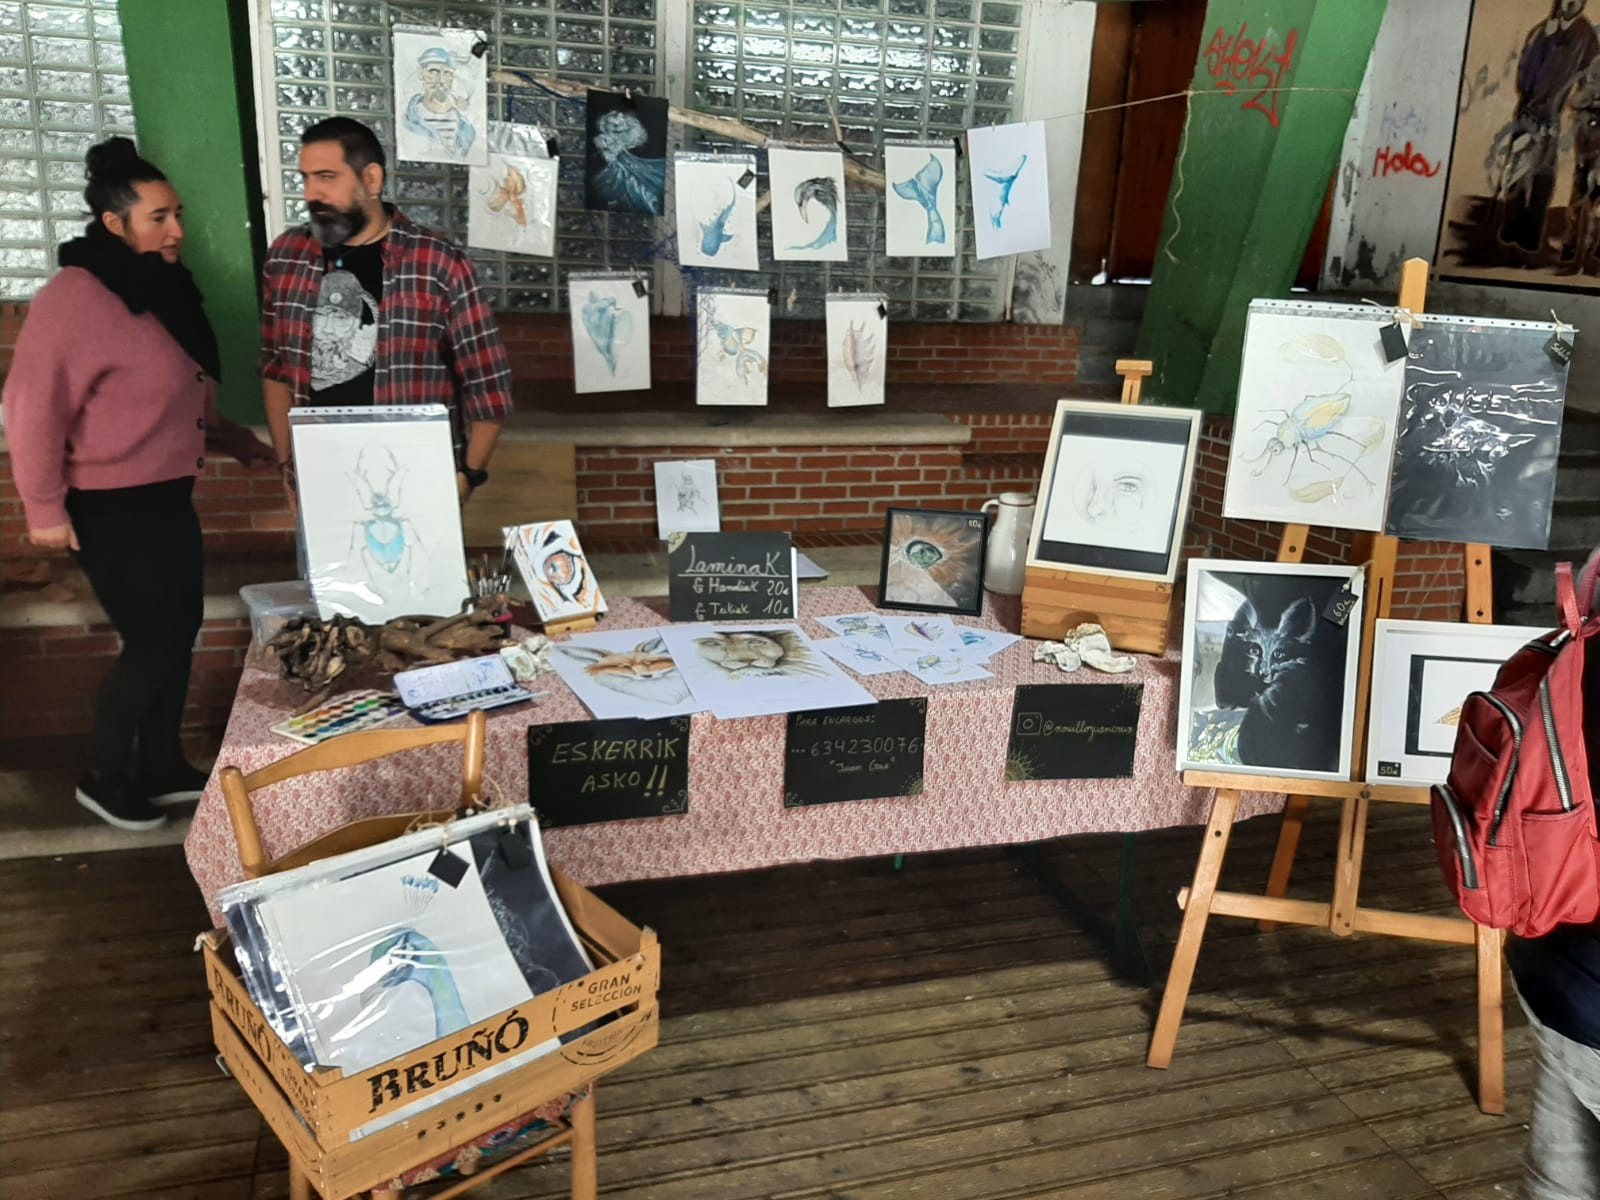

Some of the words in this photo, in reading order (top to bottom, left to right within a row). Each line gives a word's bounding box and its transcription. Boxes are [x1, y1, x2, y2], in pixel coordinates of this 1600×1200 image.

[1372, 141, 1441, 178] Hola
[767, 580, 789, 596] 20€
[762, 599, 789, 615] 10€
[588, 973, 631, 995] GRAN
[571, 984, 642, 1013] SELECCIÓN
[366, 1009, 530, 1114] BRUÑÓ
